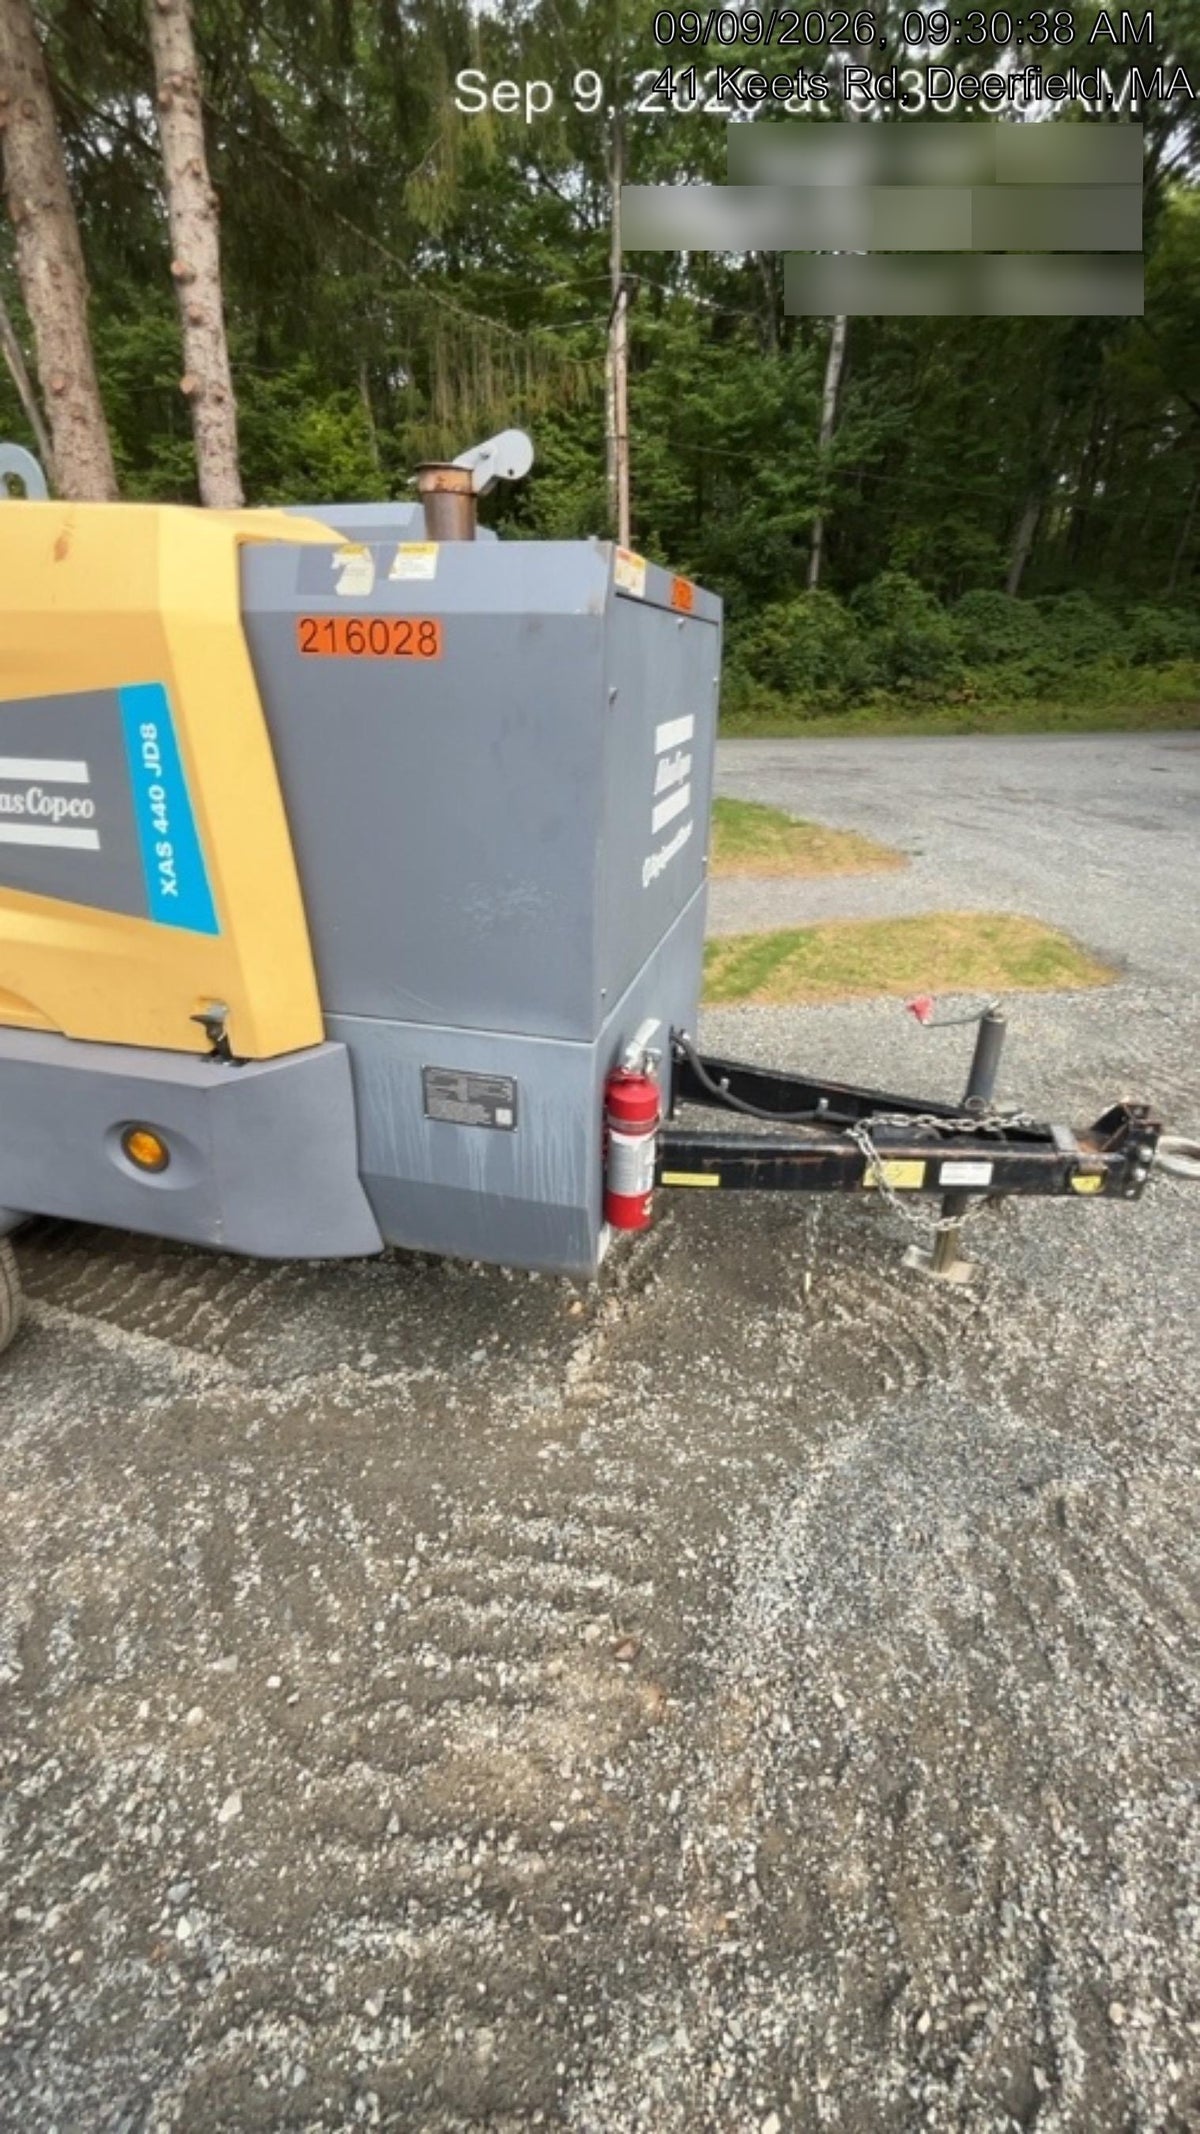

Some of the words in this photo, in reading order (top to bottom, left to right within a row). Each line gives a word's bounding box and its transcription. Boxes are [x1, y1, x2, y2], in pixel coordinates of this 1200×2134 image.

[300, 618, 437, 657] 216028
[140, 722, 162, 777] JD8
[149, 784, 169, 833] 440
[156, 841, 179, 897] XAS
